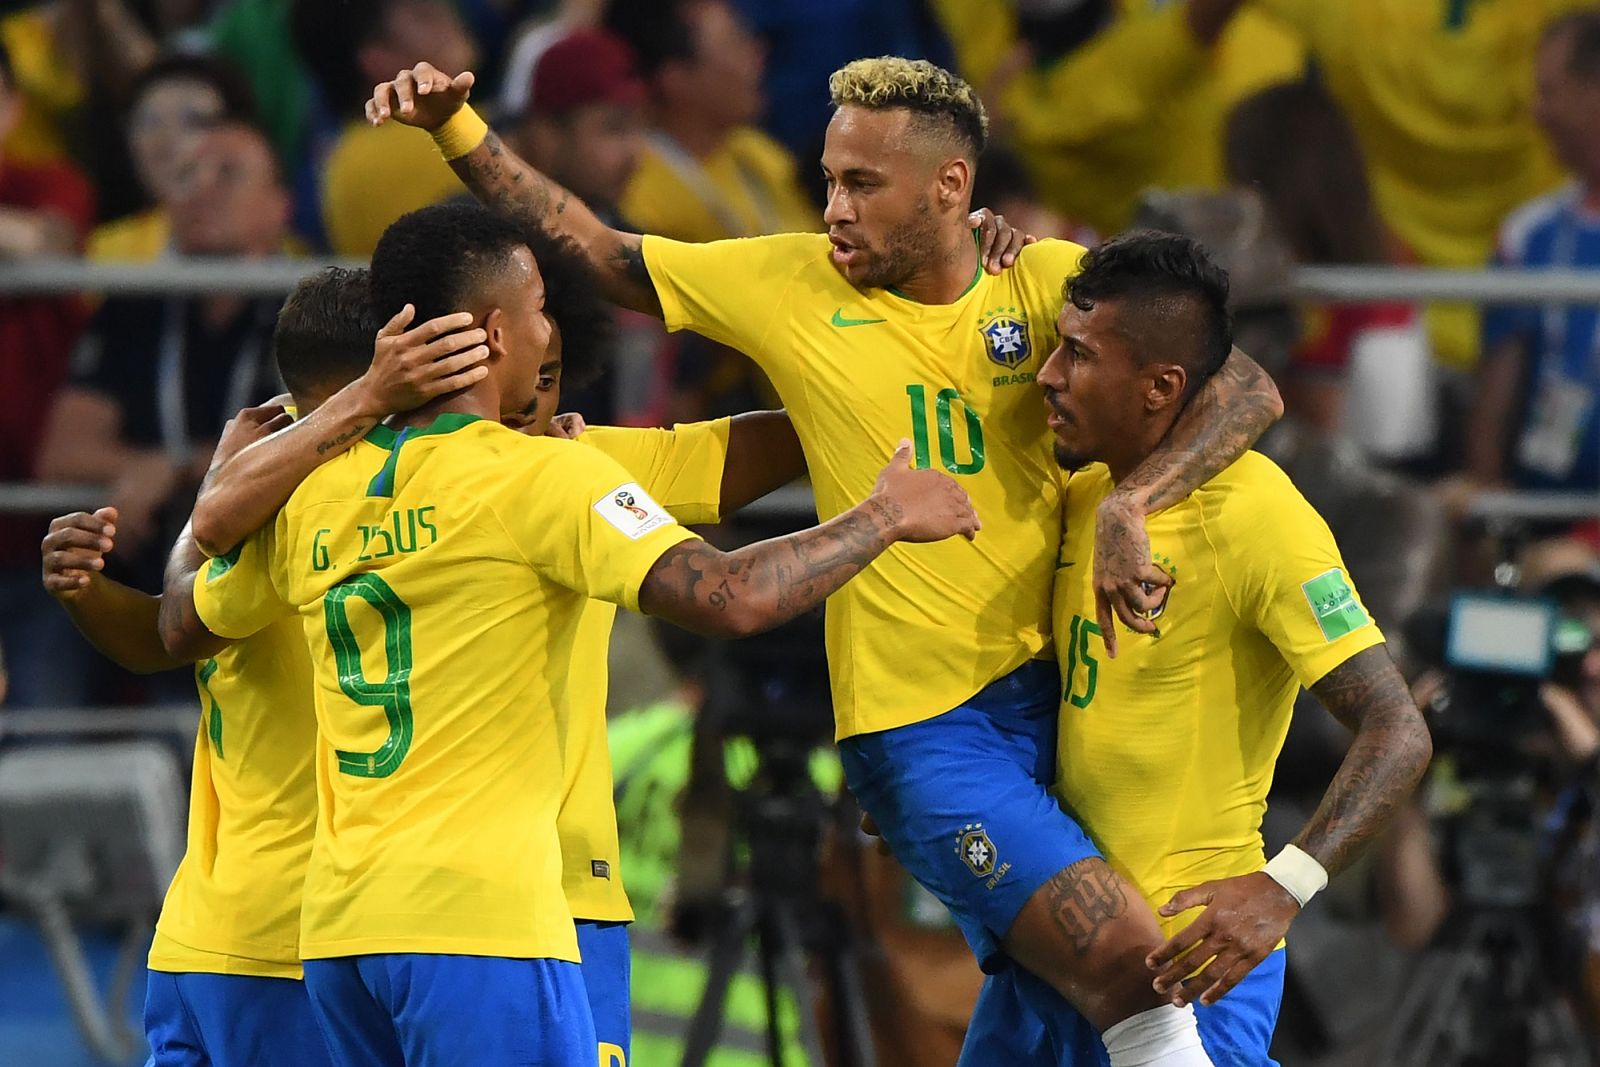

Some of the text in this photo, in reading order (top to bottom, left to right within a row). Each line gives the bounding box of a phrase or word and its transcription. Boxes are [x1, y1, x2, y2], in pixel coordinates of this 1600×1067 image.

[1000, 335, 1015, 343] CBF
[993, 372, 1037, 387] BRASIL
[906, 384, 985, 475] 10
[312, 528, 337, 571] G.
[708, 579, 735, 612] 97
[324, 572, 415, 779] 9
[1063, 614, 1104, 709] 15
[985, 861, 1012, 890] BRASIL
